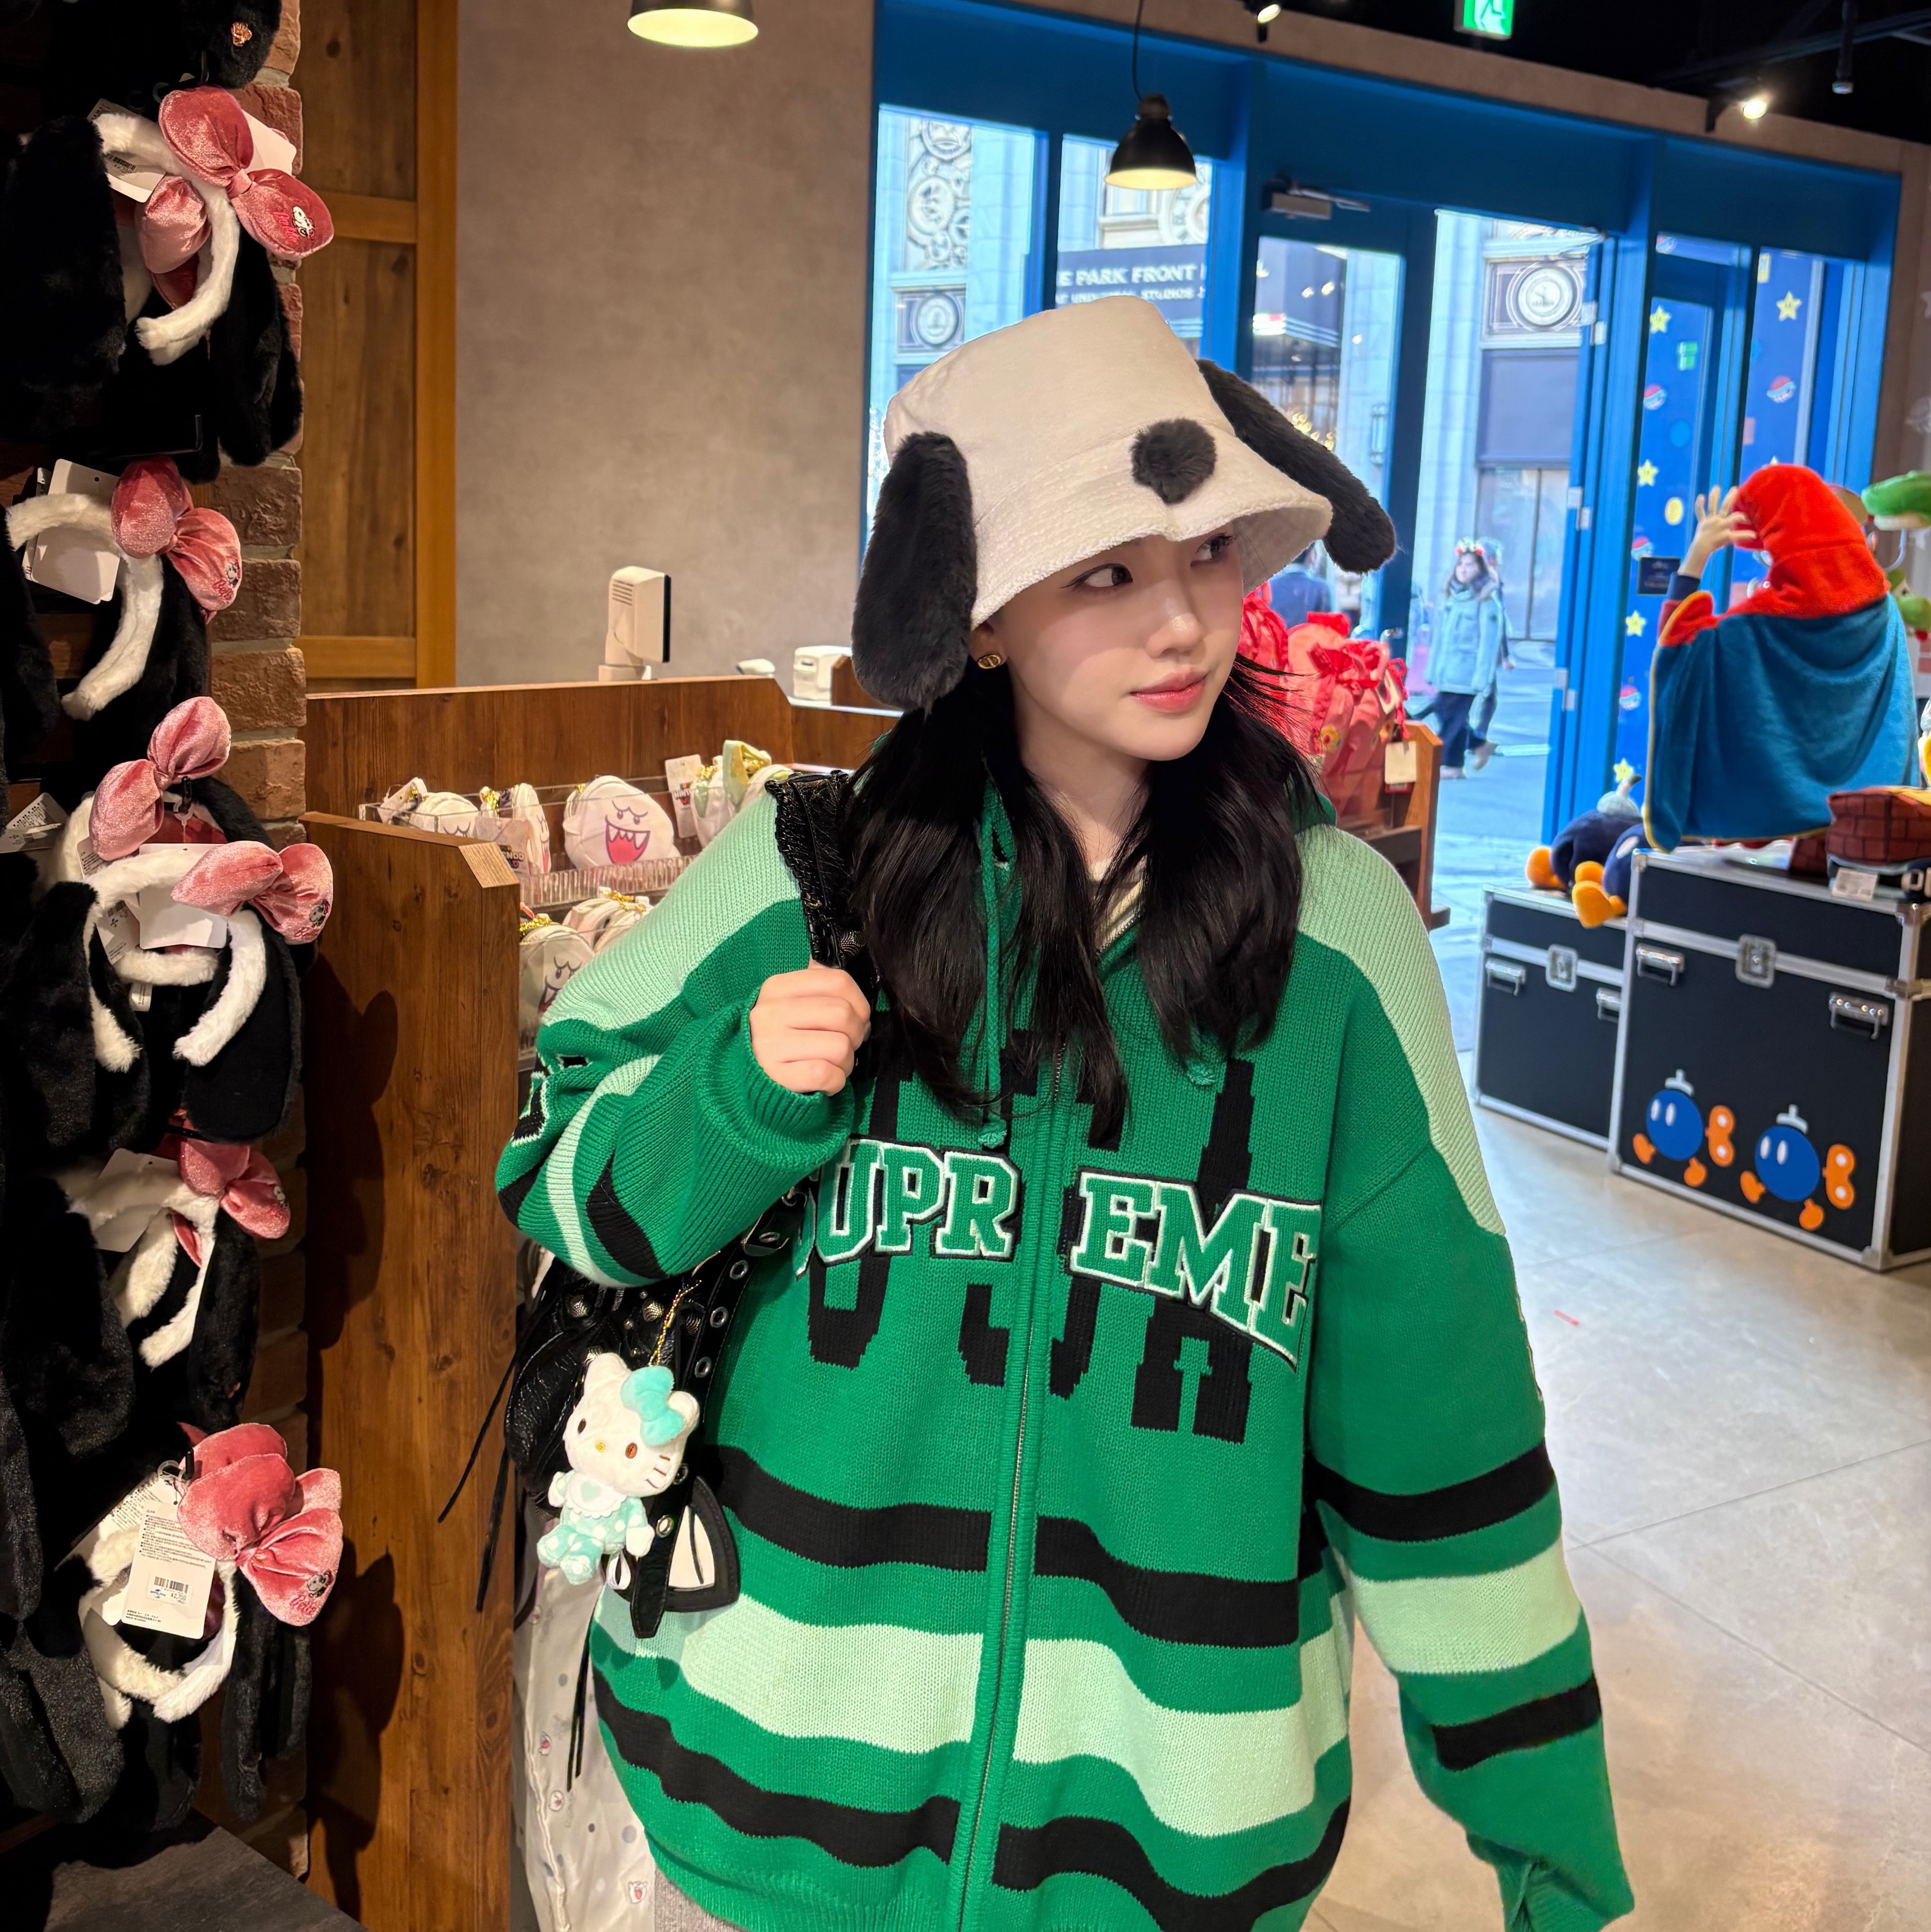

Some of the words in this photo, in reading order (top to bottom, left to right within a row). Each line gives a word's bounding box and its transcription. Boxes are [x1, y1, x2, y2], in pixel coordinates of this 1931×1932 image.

[1076, 269, 1128, 286] PARK
[1132, 264, 1197, 283] FRONT
[797, 1137, 1321, 1372] UPREME
